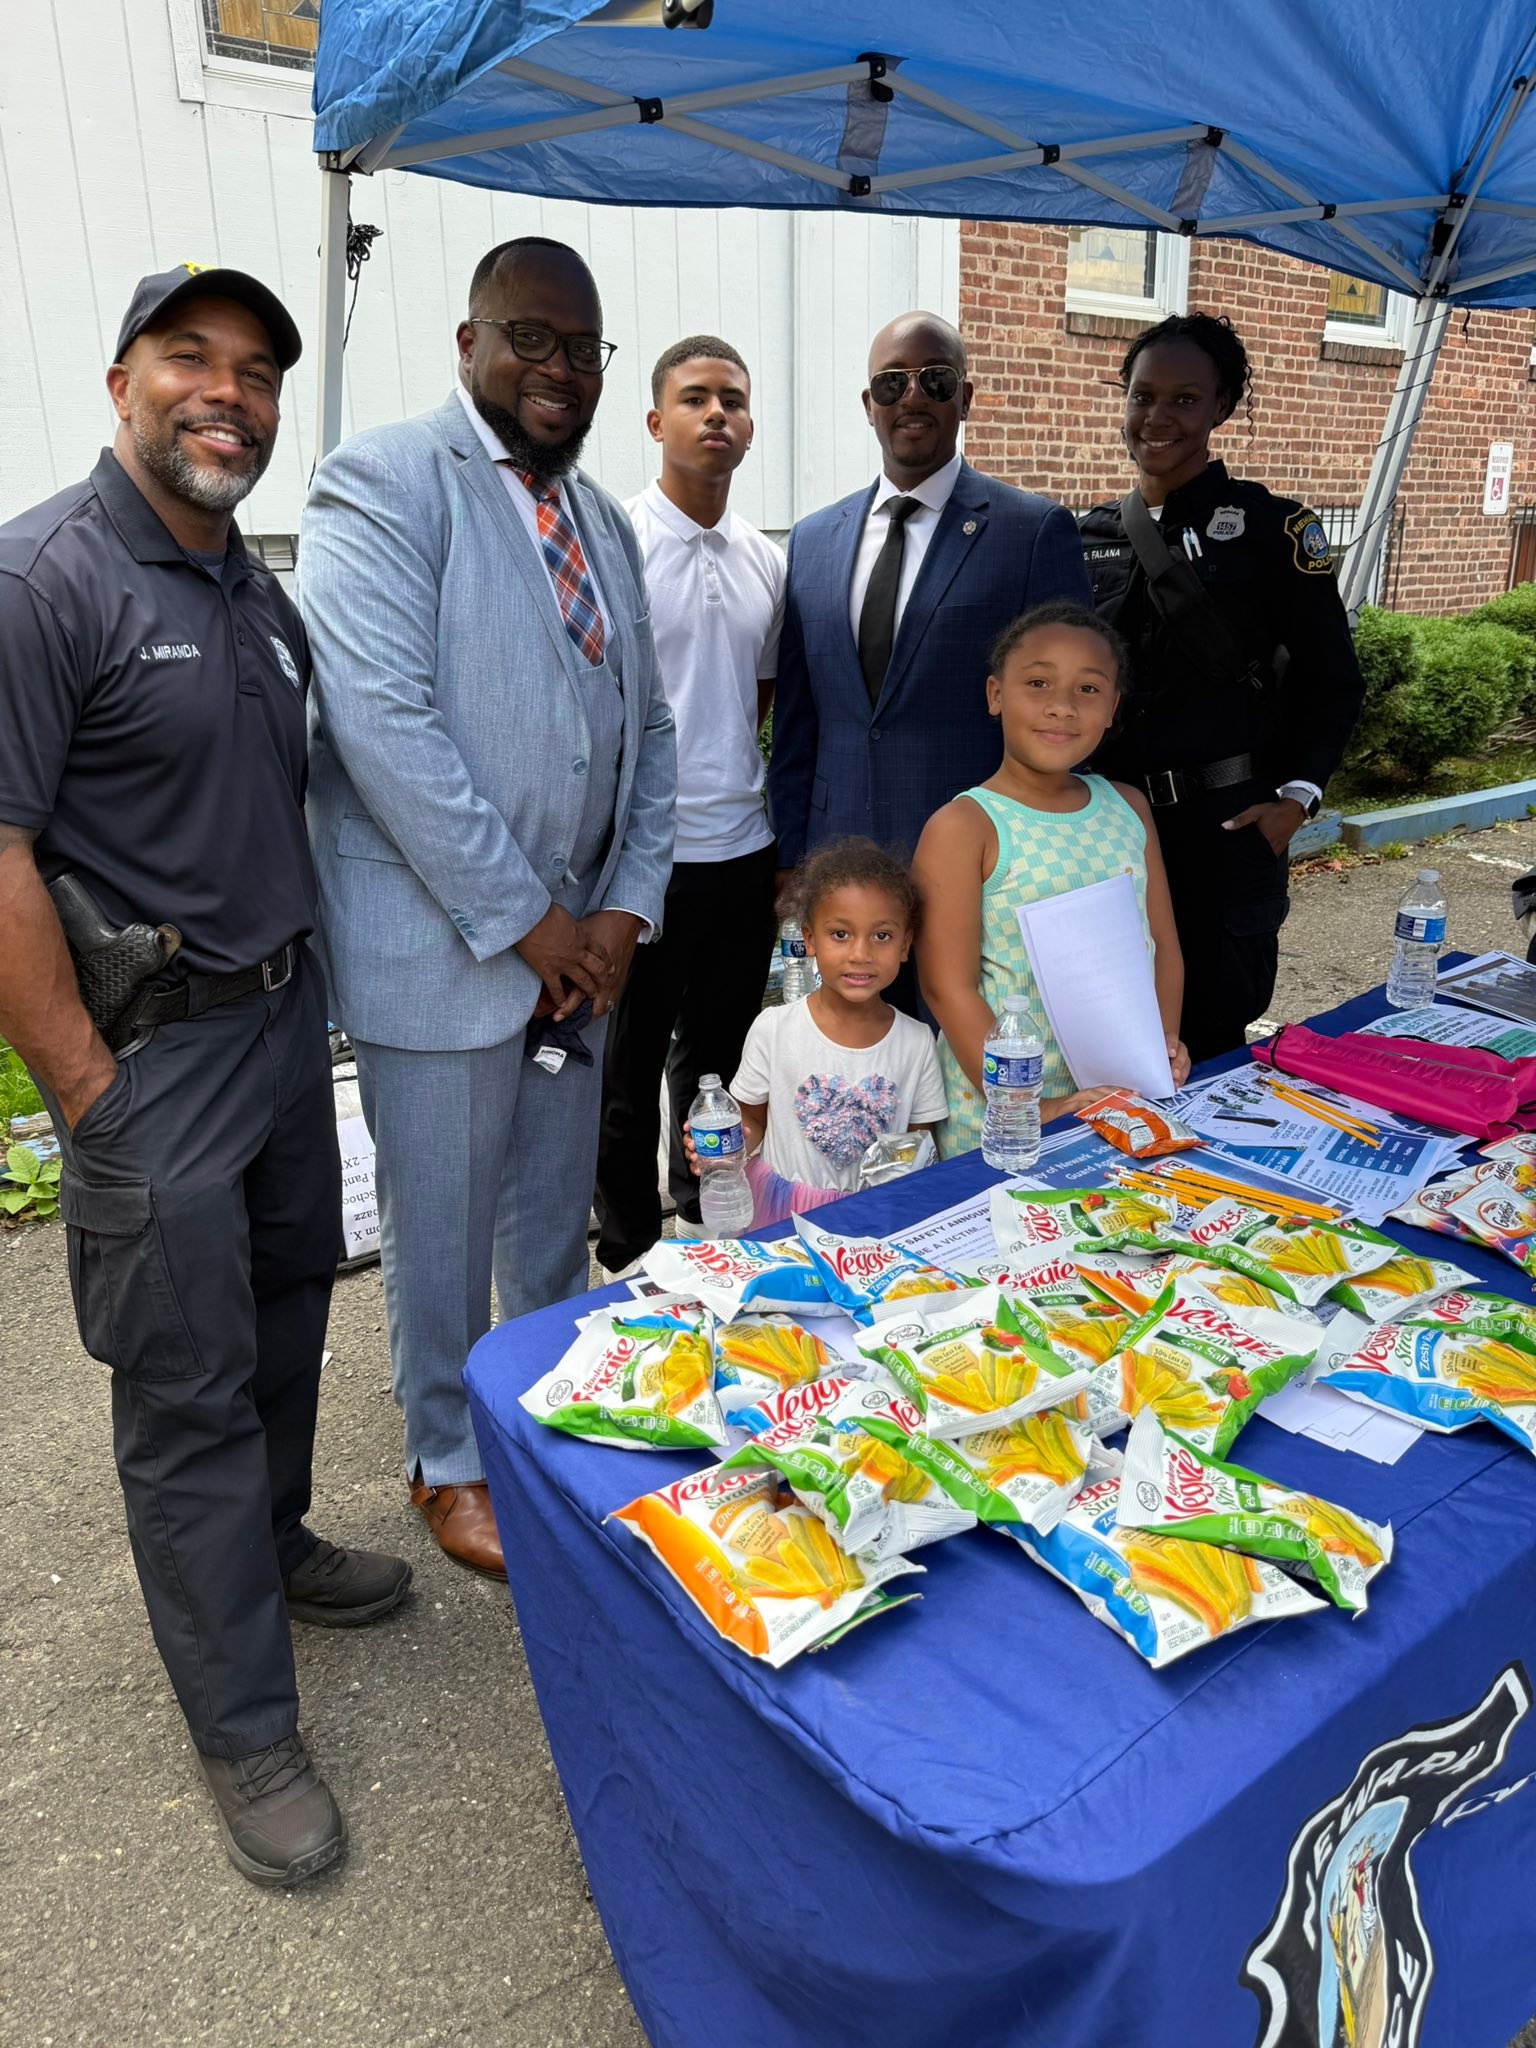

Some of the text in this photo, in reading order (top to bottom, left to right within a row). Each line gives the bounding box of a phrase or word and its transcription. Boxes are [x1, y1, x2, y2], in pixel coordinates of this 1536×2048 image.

[1091, 548, 1121, 560] FALANA
[140, 644, 201, 660] J. MIRANDA
[1056, 1152, 1094, 1170] Newark
[1494, 1161, 1516, 1181] ldfish
[1065, 1164, 1096, 1180] Guard
[1492, 1201, 1516, 1228] Goldfish
[905, 1225, 946, 1246] SAFETY
[915, 1246, 933, 1257] BE
[820, 1245, 901, 1282] Veggie
[1178, 1339, 1230, 1365] Sea Salt
[1395, 1325, 1420, 1367] Stra
[1419, 1341, 1432, 1370] Zesty
[930, 1351, 943, 1364] 30%
[1163, 1448, 1217, 1521] Veggie
[736, 1532, 750, 1547] 30%
